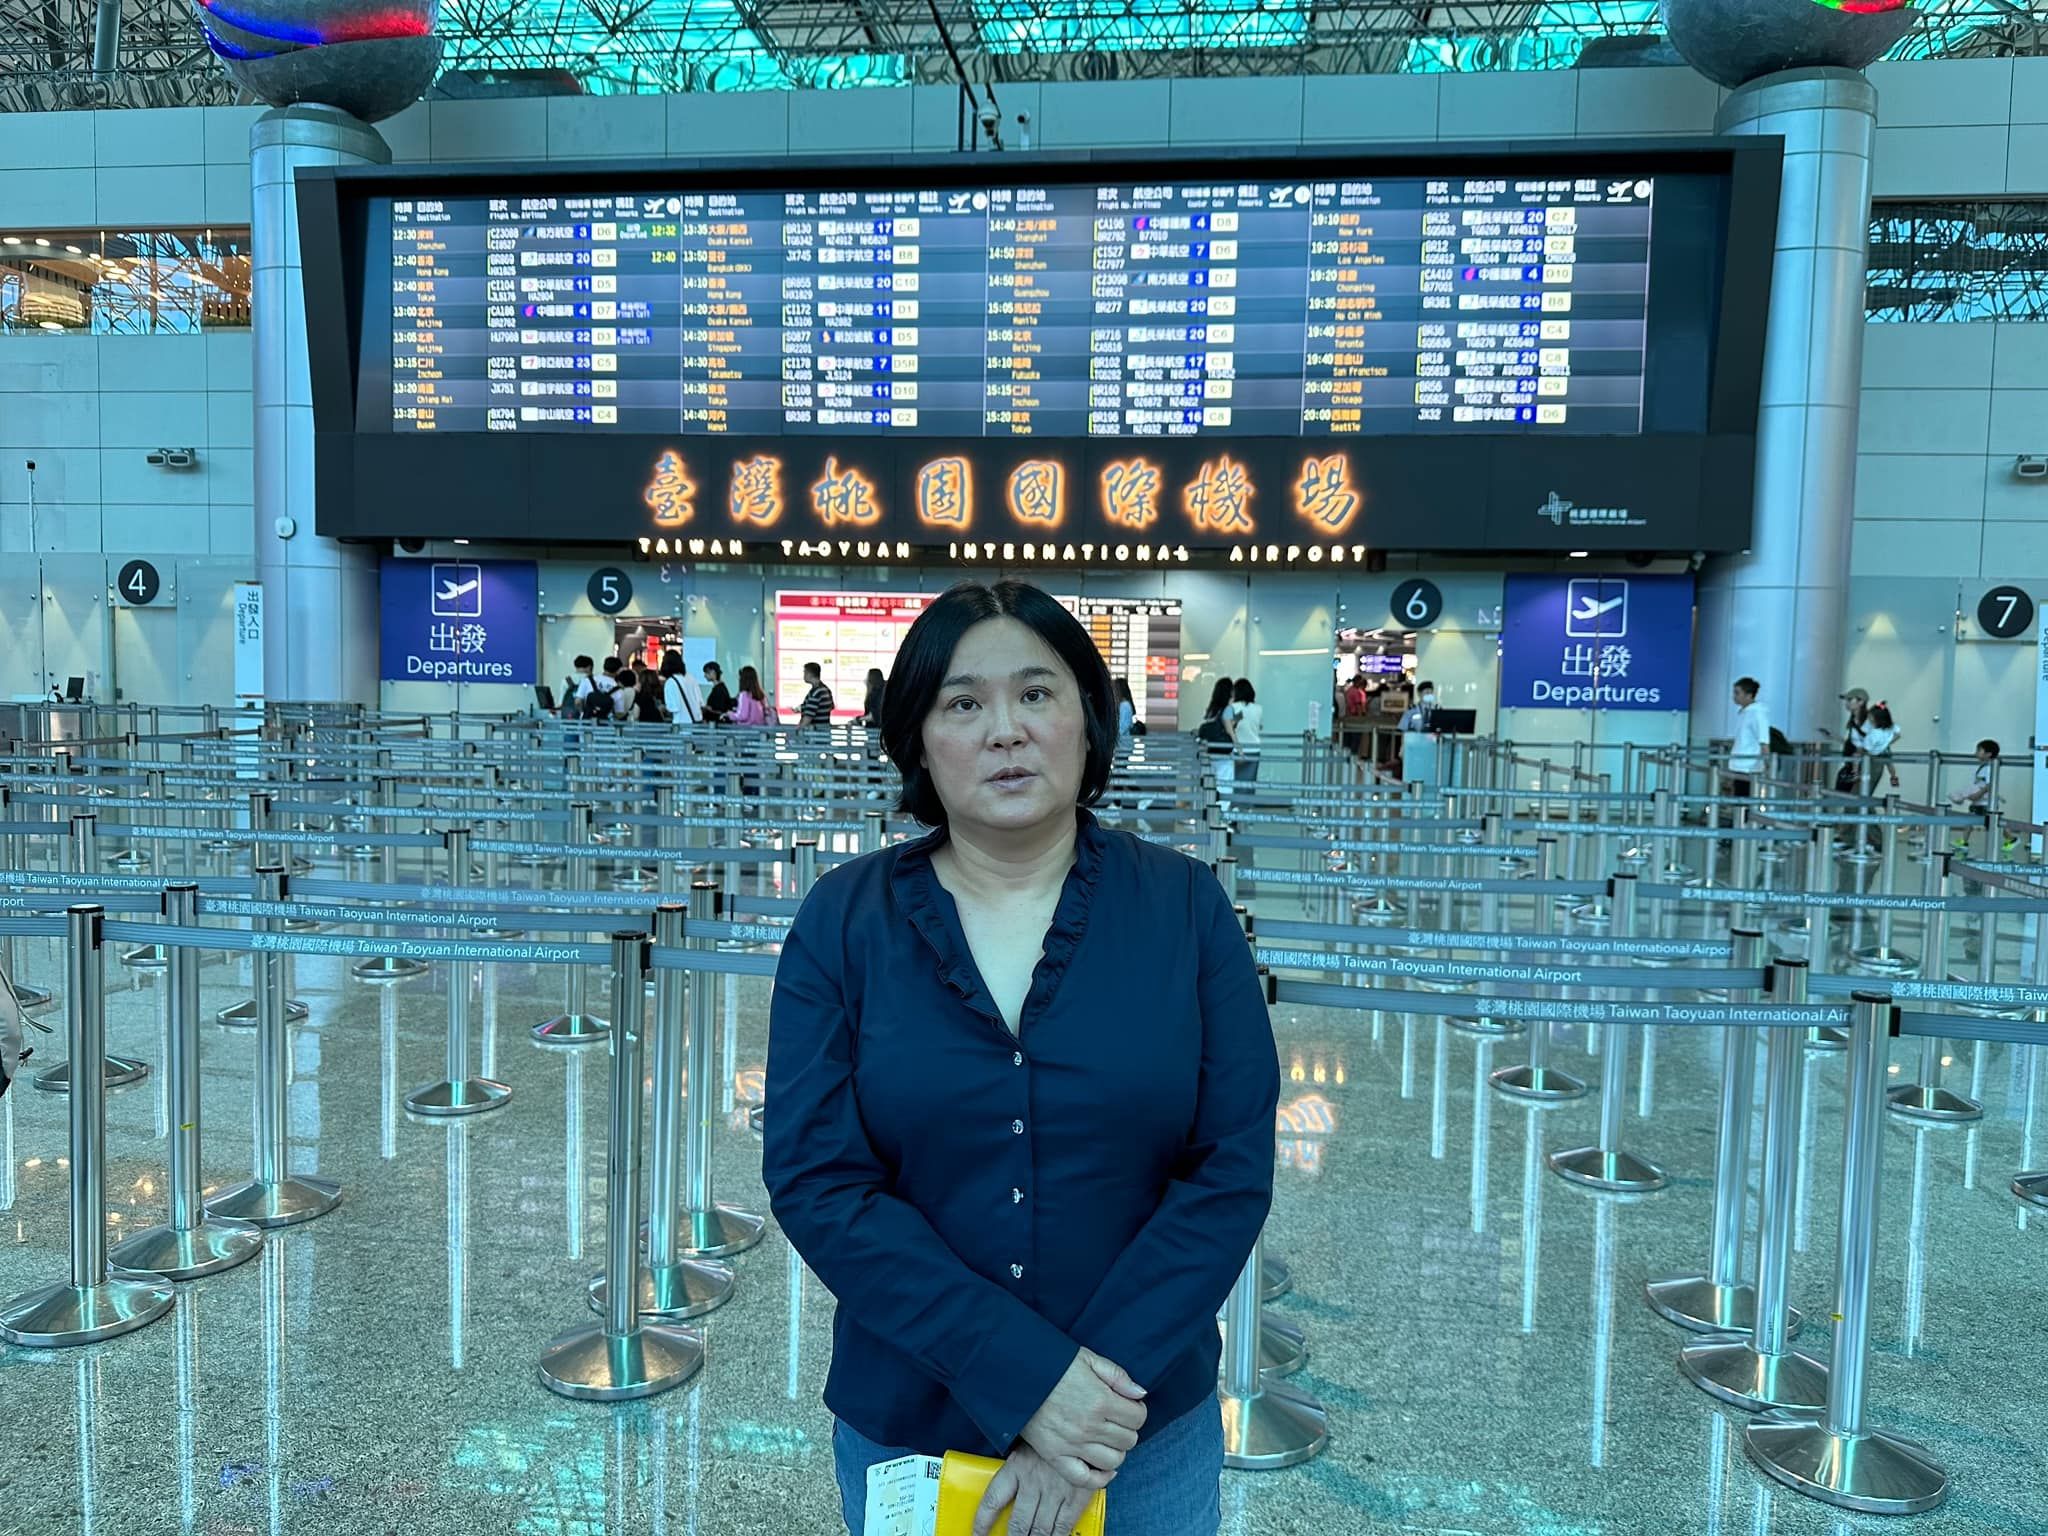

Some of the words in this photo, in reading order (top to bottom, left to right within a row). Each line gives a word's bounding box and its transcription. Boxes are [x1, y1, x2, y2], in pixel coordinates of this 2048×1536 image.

[1196, 216, 1206, 229] 4
[1528, 212, 1544, 223] 20
[579, 226, 588, 238] 3
[878, 222, 891, 233] 17
[1196, 244, 1205, 257] 7
[577, 253, 590, 264] 20
[1195, 273, 1204, 285] 3
[1528, 267, 1538, 280] 4
[577, 280, 589, 289] 11
[877, 277, 891, 288] 20
[1191, 301, 1206, 312] 20
[1524, 296, 1540, 307] 20
[579, 305, 588, 316] 4
[877, 304, 889, 314] 11
[1190, 329, 1205, 340] 20
[1523, 325, 1538, 335] 20
[577, 332, 590, 342] 22
[577, 358, 590, 368] 23
[879, 357, 888, 369] 7
[1190, 356, 1203, 367] 17
[877, 386, 888, 396] 11
[577, 410, 590, 419] 24
[876, 412, 889, 422] 20
[638, 537, 743, 555] TAIWAN
[780, 539, 910, 559] TAOYUAN
[949, 542, 1189, 562] INTERNATIONAL
[1229, 544, 1366, 562] AIRPORT
[127, 568, 146, 596] 4
[601, 576, 619, 606] 5
[1405, 588, 1428, 620] 6
[1996, 596, 2017, 629] 7
[429, 623, 488, 654] 出發
[406, 655, 513, 679] Departures
[1561, 645, 1632, 678] 出發
[1532, 678, 1660, 706] Departures
[198, 829, 223, 839] Taiwan
[226, 831, 256, 842] Taoyuan
[258, 831, 306, 842] International
[307, 833, 335, 844] Airport
[534, 843, 562, 853] Taiwan
[564, 844, 598, 856] Taoyuan
[600, 846, 651, 858] International
[651, 849, 682, 860] Airport
[26, 873, 59, 885] Taiwan
[60, 875, 99, 887] Taoyuan
[101, 876, 161, 888] International
[1313, 873, 1345, 884] Taiwan
[1347, 875, 1386, 888] Taoyuan
[1388, 876, 1447, 889] International
[1448, 879, 1483, 891] Airport
[511, 891, 547, 902] Taiwan
[550, 893, 592, 906] Taoyuan
[594, 893, 659, 906] International
[1768, 892, 1802, 903] Taiwan
[1803, 893, 1844, 908] Taoyuan
[1846, 895, 1909, 908] International
[1909, 897, 1946, 911] Airport
[300, 904, 336, 917] Taiwan
[339, 907, 384, 922] Taoyuan
[386, 909, 455, 924] International
[457, 913, 498, 928] Airport
[358, 942, 398, 954] Taiwan
[400, 943, 451, 958] Taoyuan
[454, 944, 532, 959] International
[534, 947, 581, 961] Airport
[1515, 936, 1557, 949] Taiwan
[1559, 938, 1608, 953] Taoyuan
[1612, 939, 1690, 955] International
[1691, 943, 1733, 958] Airpor
[1343, 957, 1387, 970] Taiwan
[1390, 958, 1444, 975] Taoyuan
[1447, 963, 1531, 979] International
[1534, 967, 1582, 983] Airport
[2017, 988, 2048, 1001] Taiw
[1609, 1004, 1659, 1019] Taiwan
[1664, 1005, 1725, 1022] Taoyuan
[1729, 1007, 1823, 1022] International
